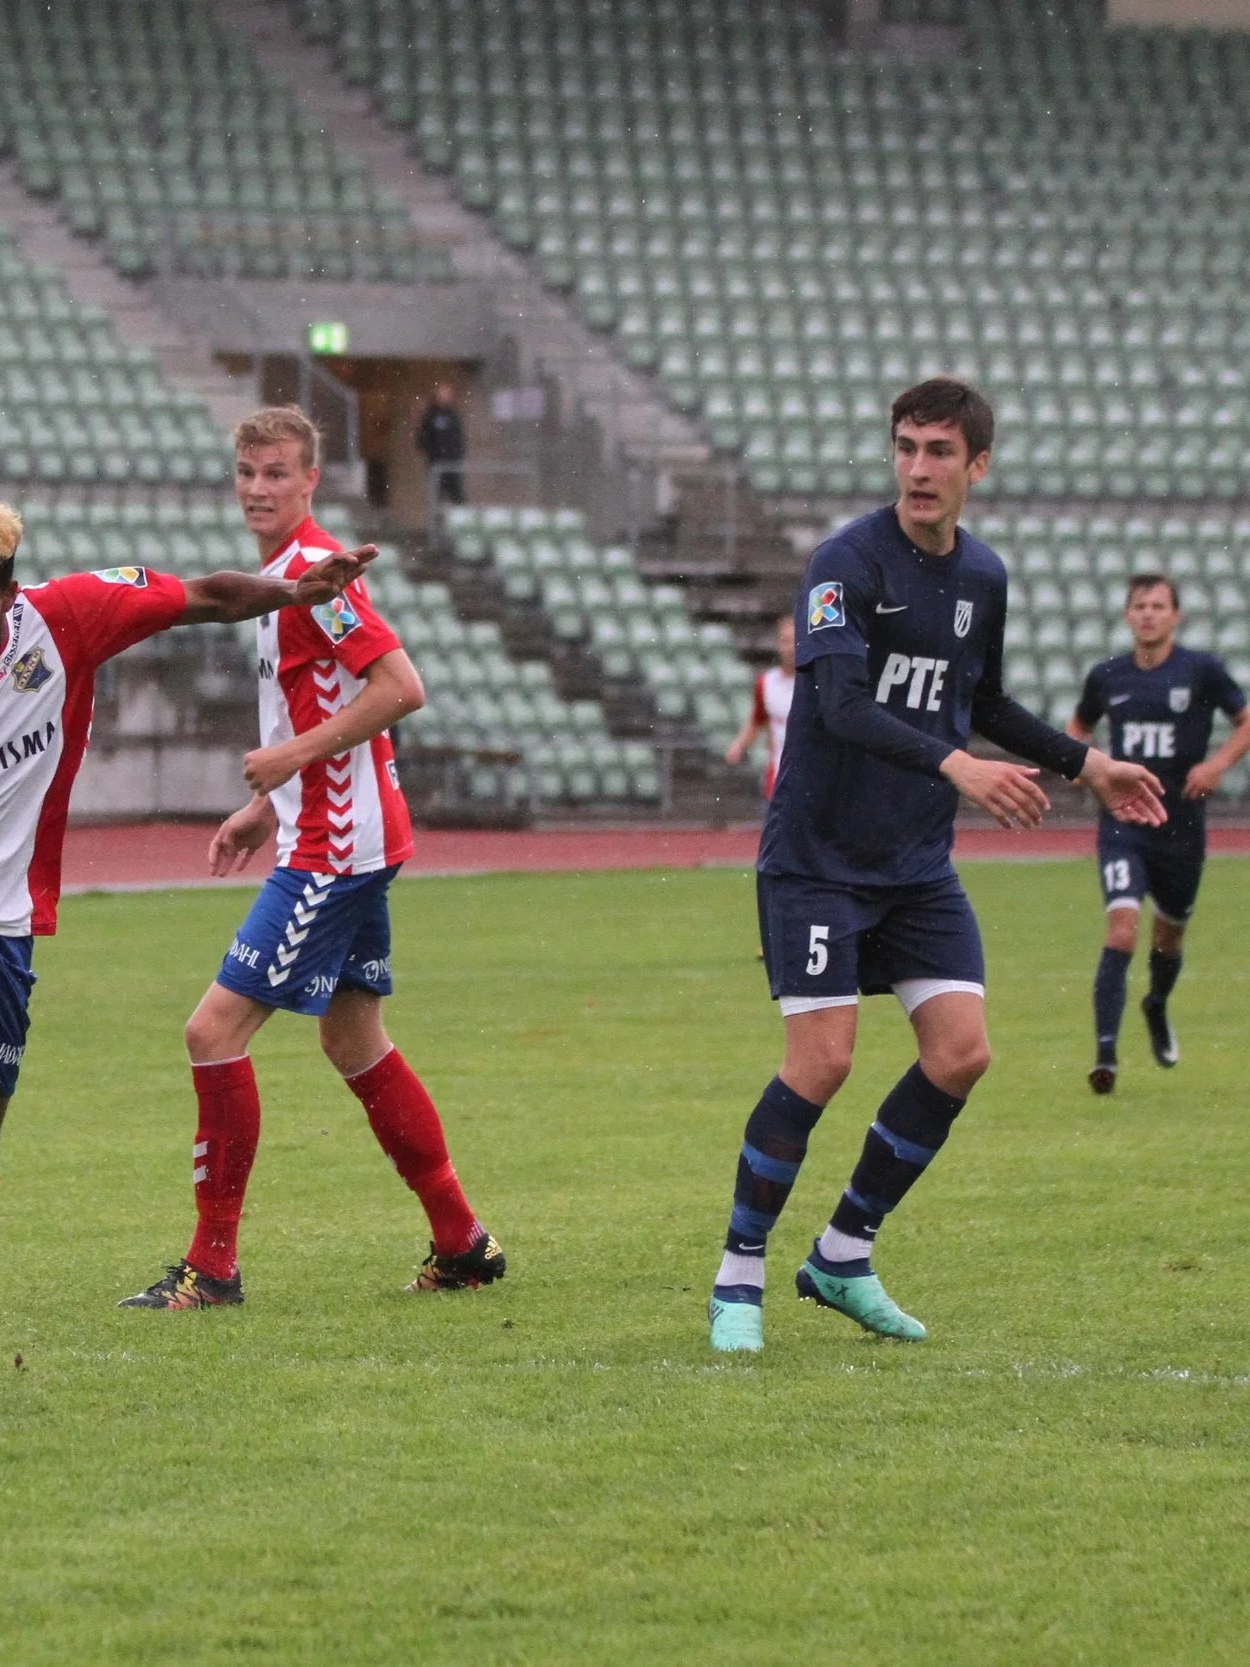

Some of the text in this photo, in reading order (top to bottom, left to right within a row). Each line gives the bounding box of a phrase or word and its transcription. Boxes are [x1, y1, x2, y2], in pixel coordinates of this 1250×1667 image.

[875, 652, 949, 712] PTE
[1121, 721, 1176, 758] PTE
[1103, 858, 1131, 891] 13
[805, 925, 830, 976] 5
